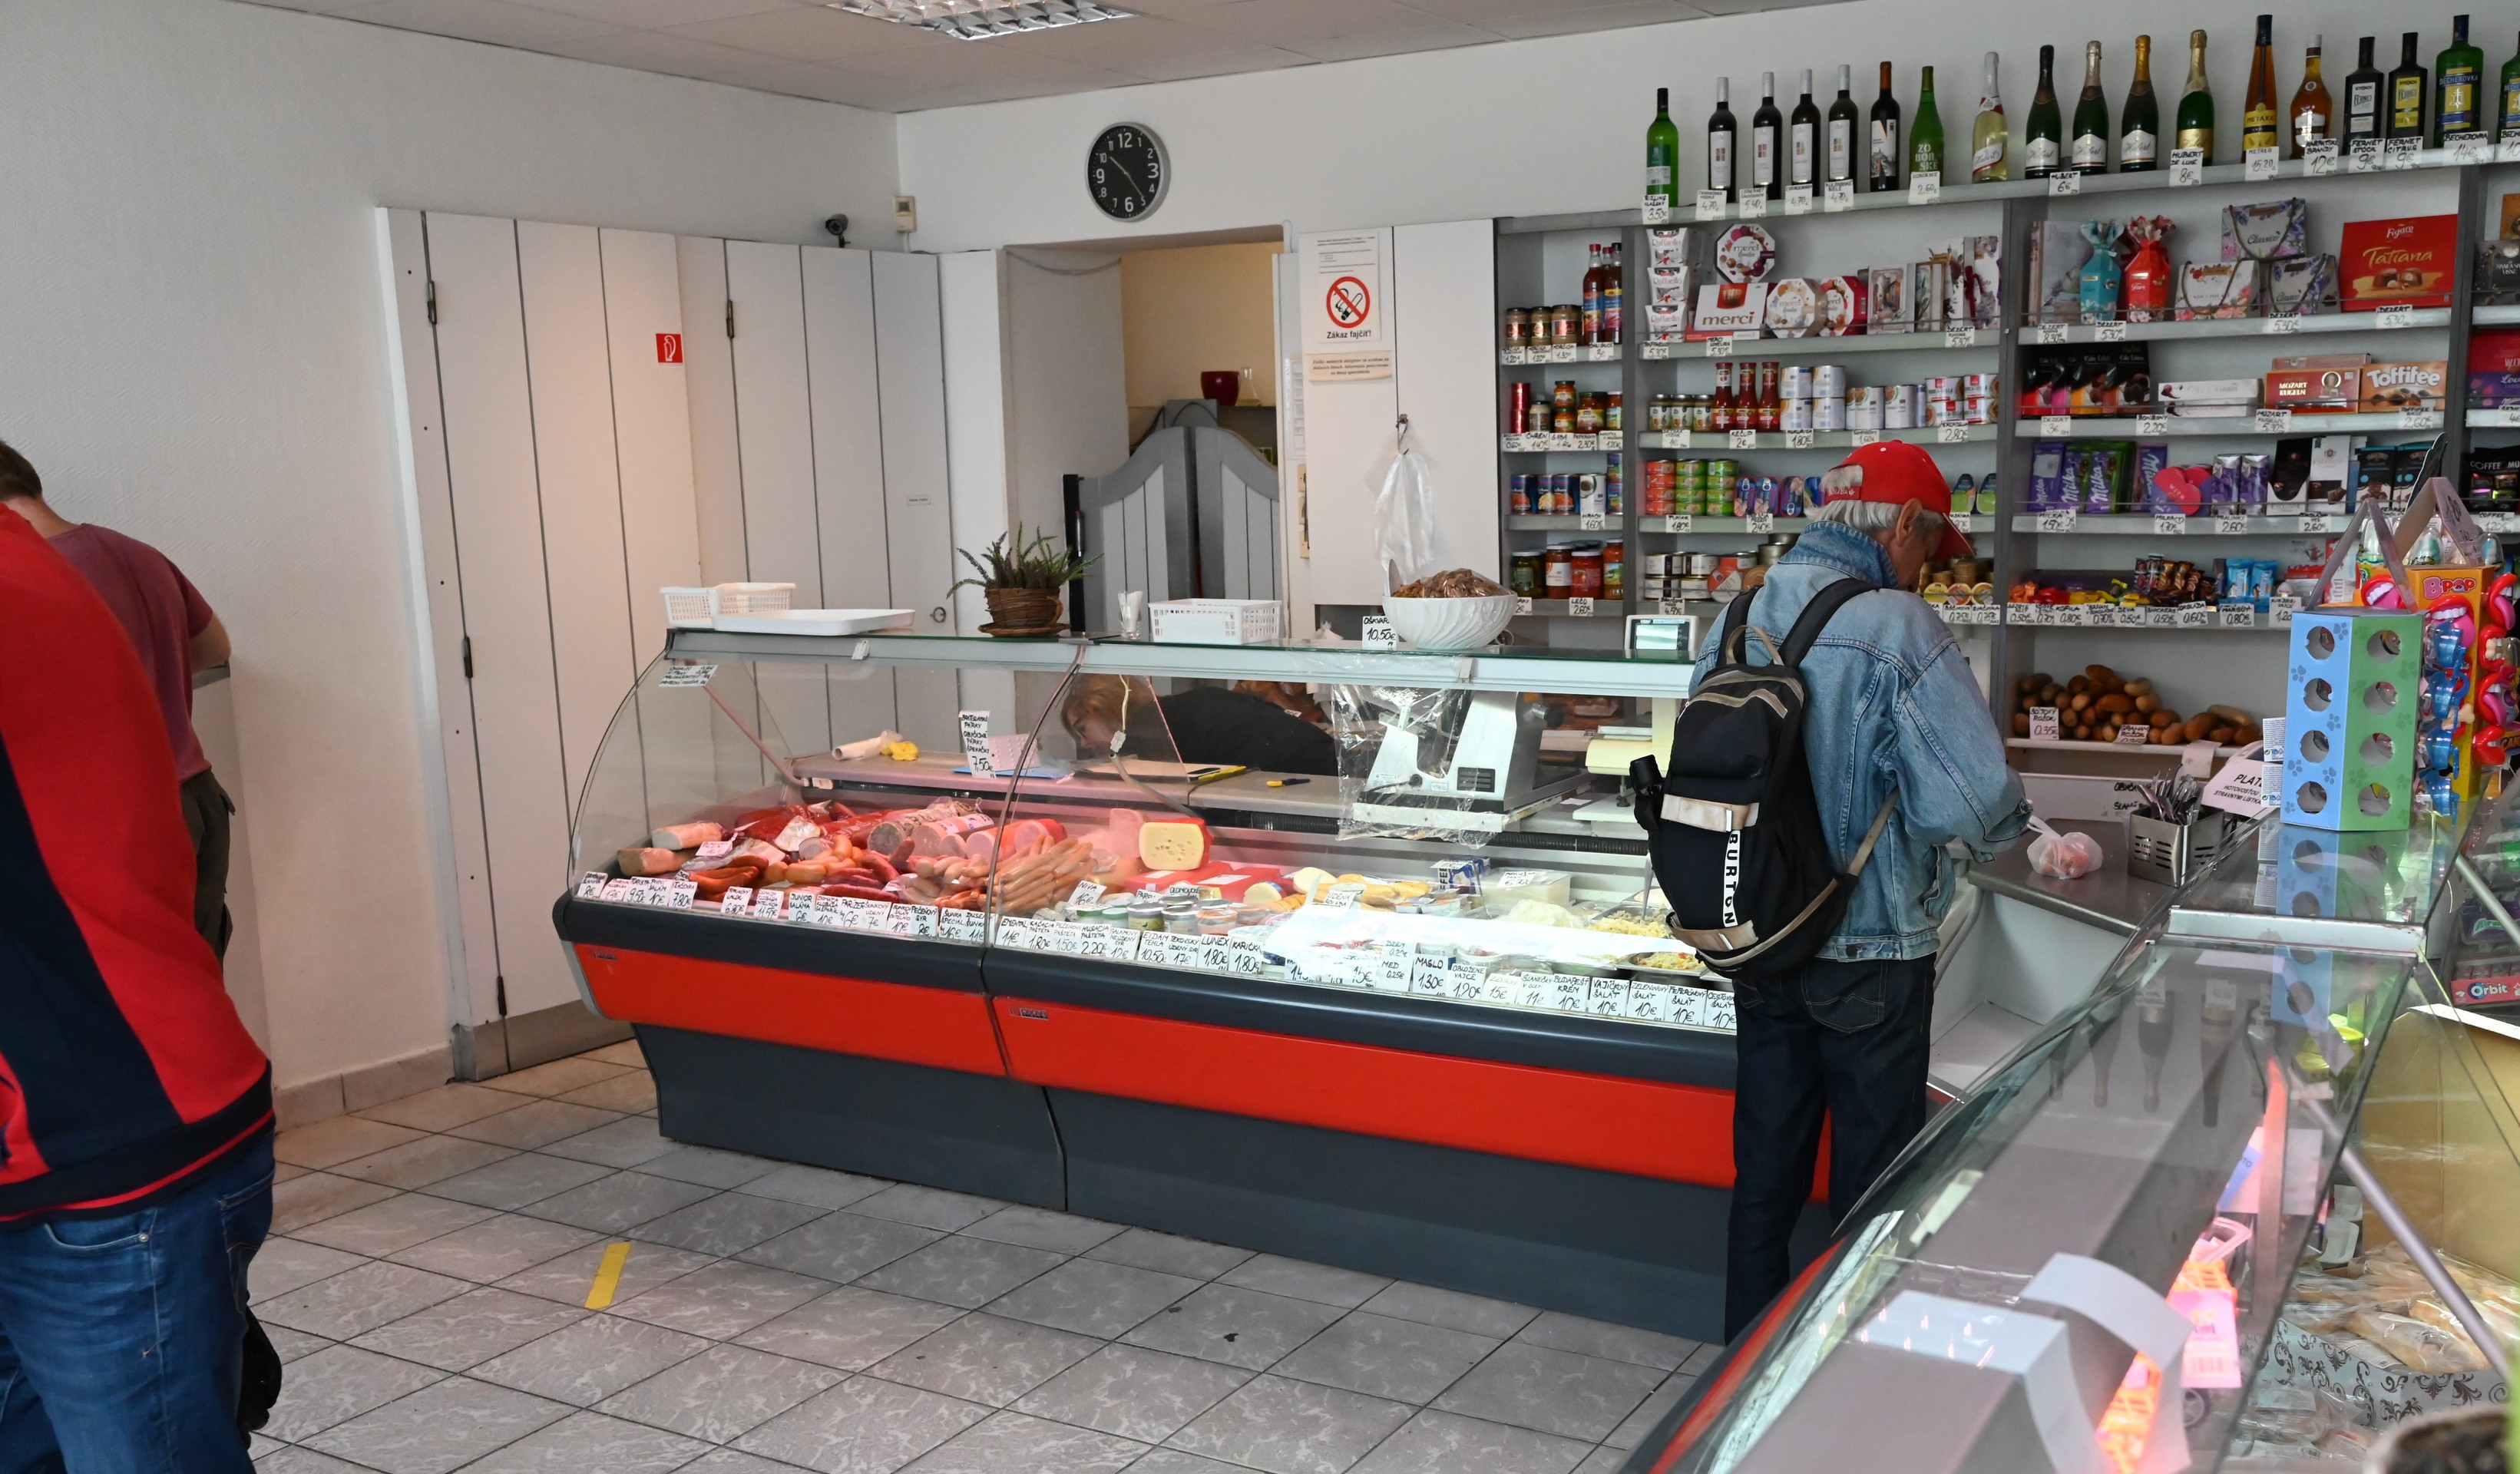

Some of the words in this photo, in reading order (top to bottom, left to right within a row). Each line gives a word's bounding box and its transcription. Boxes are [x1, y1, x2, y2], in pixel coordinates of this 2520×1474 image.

[2439, 75, 2479, 85] BECHEROVKA
[1118, 132, 1133, 149] 12
[1138, 137, 1142, 147] 1
[2388, 137, 2422, 146] FERNET
[2445, 133, 2488, 141] BECHEROVKA
[1100, 152, 1107, 164] 10
[1147, 148, 1154, 159] 2
[1147, 163, 1159, 179] 3
[2311, 155, 2335, 174] 12€
[1096, 168, 1105, 184] 9
[2180, 168, 2194, 183] 8€
[1100, 187, 1107, 197] 8
[1149, 183, 1155, 193] 4
[2058, 181, 2071, 193] 6€
[1113, 197, 1118, 208] 7
[1124, 197, 1134, 213] 6
[1734, 244, 1759, 253] merci
[2363, 246, 2432, 269] Tatiana
[1702, 312, 1755, 326] merci
[1327, 331, 1348, 339] Zákaz
[2367, 366, 2440, 388] Toffifee
[2470, 461, 2502, 470] COFFEE
[2062, 467, 2080, 503] Milka
[2091, 465, 2108, 503] Milka
[1367, 628, 1396, 642] 10,50€
[1725, 834, 1738, 924] BURTON
[1078, 881, 1096, 891] NIVA
[791, 894, 812, 903] JUNIOR
[795, 910, 807, 921] 6€
[915, 915, 928, 924] SYR
[944, 909, 962, 919] ŠUNKA
[868, 917, 879, 928] 7€
[1082, 925, 1110, 934] HUSACIA
[1002, 930, 1020, 944] 11€
[1029, 935, 1051, 950] 1,80€
[1202, 935, 1229, 947] LUNEX
[1056, 937, 1078, 952] 1,50€
[1081, 940, 1107, 956] 2,20€
[1144, 940, 1165, 948] TEHLA
[1188, 945, 1199, 953] SYR
[1232, 940, 1262, 953] KARIČKA
[1204, 949, 1228, 967] 1,80€
[1234, 953, 1260, 973] 1,80€
[1415, 957, 1444, 970] MASLO
[1381, 960, 1401, 970] MED
[1387, 970, 1406, 981] 0,25€
[1417, 972, 1444, 990] 1,30€
[1454, 973, 1477, 982] VAJCE
[1489, 985, 1507, 1000] 15€
[2471, 983, 2509, 998] Orbit
[1558, 994, 1580, 1011] 10€
[1597, 1000, 1617, 1016] 10€
[1635, 1002, 1658, 1018] 10€
[1673, 1008, 1695, 1025] 10€
[1713, 1010, 1737, 1029] 10€
